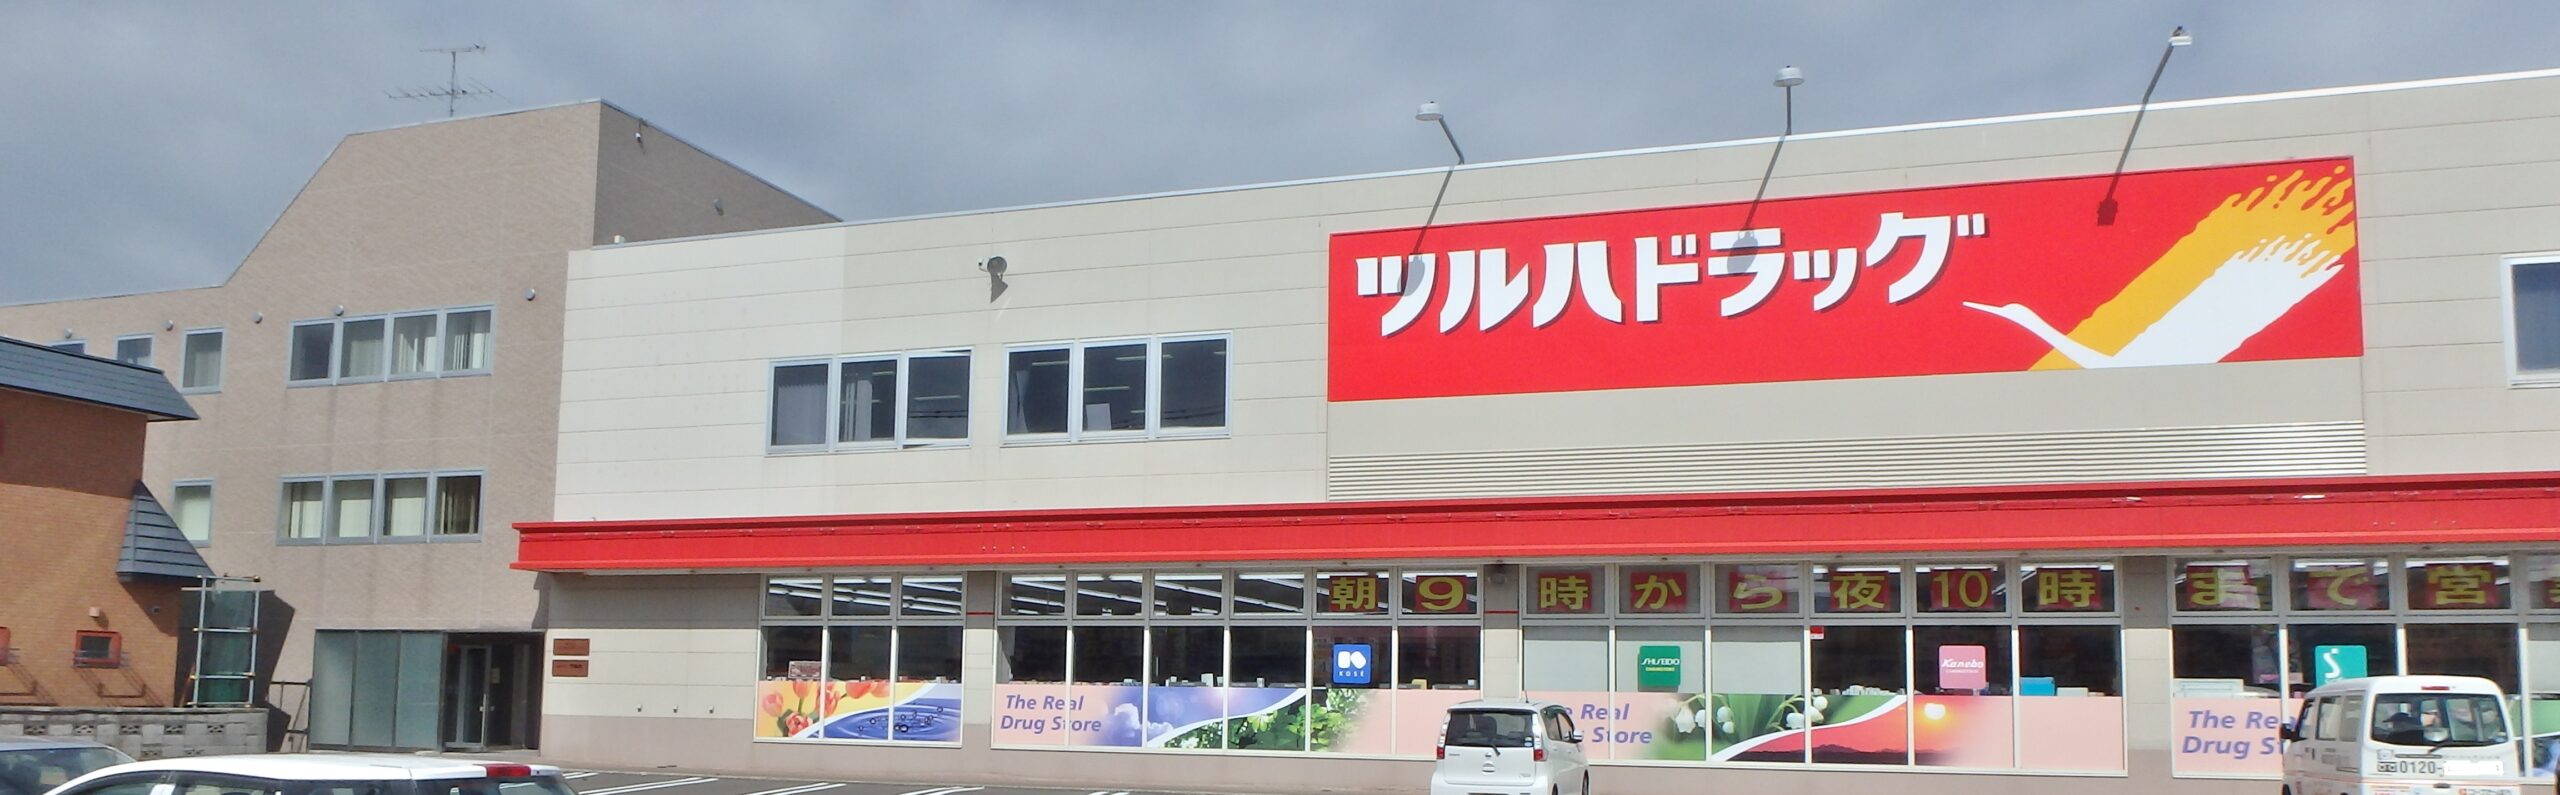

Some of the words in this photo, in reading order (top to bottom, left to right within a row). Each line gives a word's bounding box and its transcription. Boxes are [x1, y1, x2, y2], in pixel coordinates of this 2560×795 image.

[1355, 211, 1986, 337] ツルハドラッグ
[1641, 657, 1680, 666] SHISEIDO
[1941, 658, 1985, 669] Kanebo
[1006, 694, 1037, 710] The
[1043, 695, 1084, 711] Real
[1000, 715, 1045, 735] Drug
[2189, 710, 2236, 729] The
[2182, 736, 2250, 760] Drug
